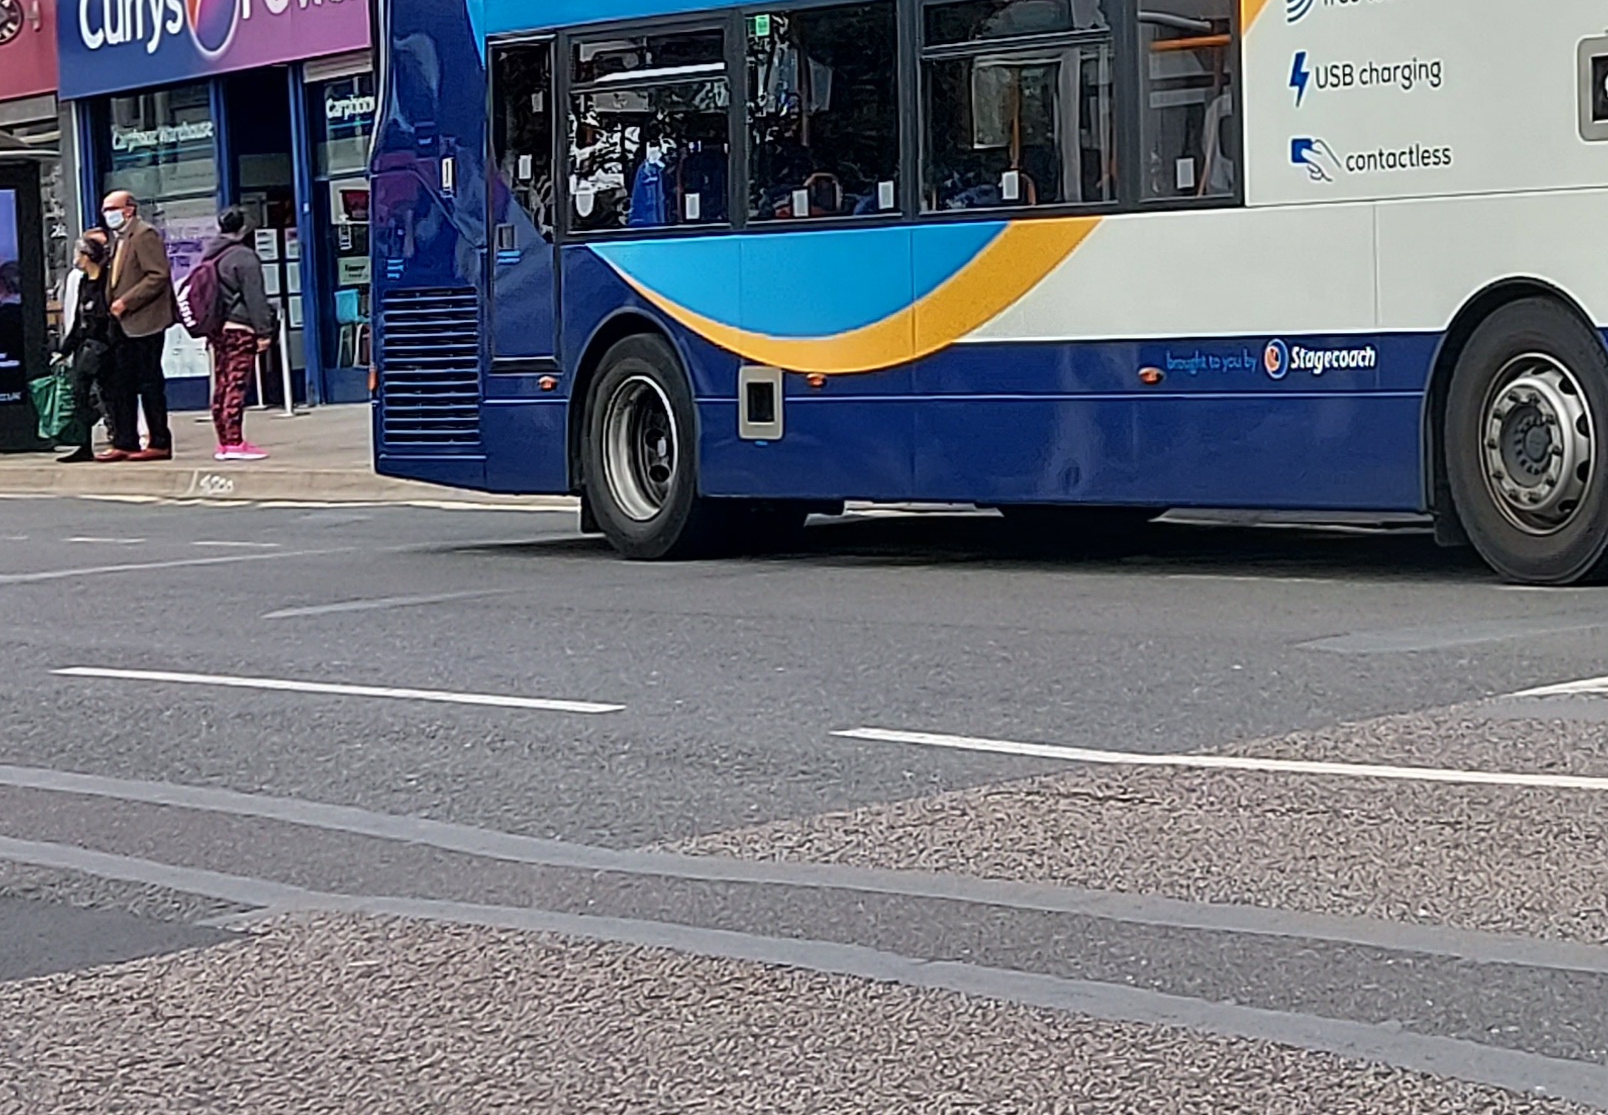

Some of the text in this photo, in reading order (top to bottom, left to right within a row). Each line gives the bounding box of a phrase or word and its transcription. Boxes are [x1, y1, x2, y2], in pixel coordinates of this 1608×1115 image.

[1315, 57, 1442, 91] USB charging
[1345, 142, 1453, 173] contactless
[1165, 347, 1259, 375] brought to you by
[1290, 345, 1376, 375] Stagecoach
